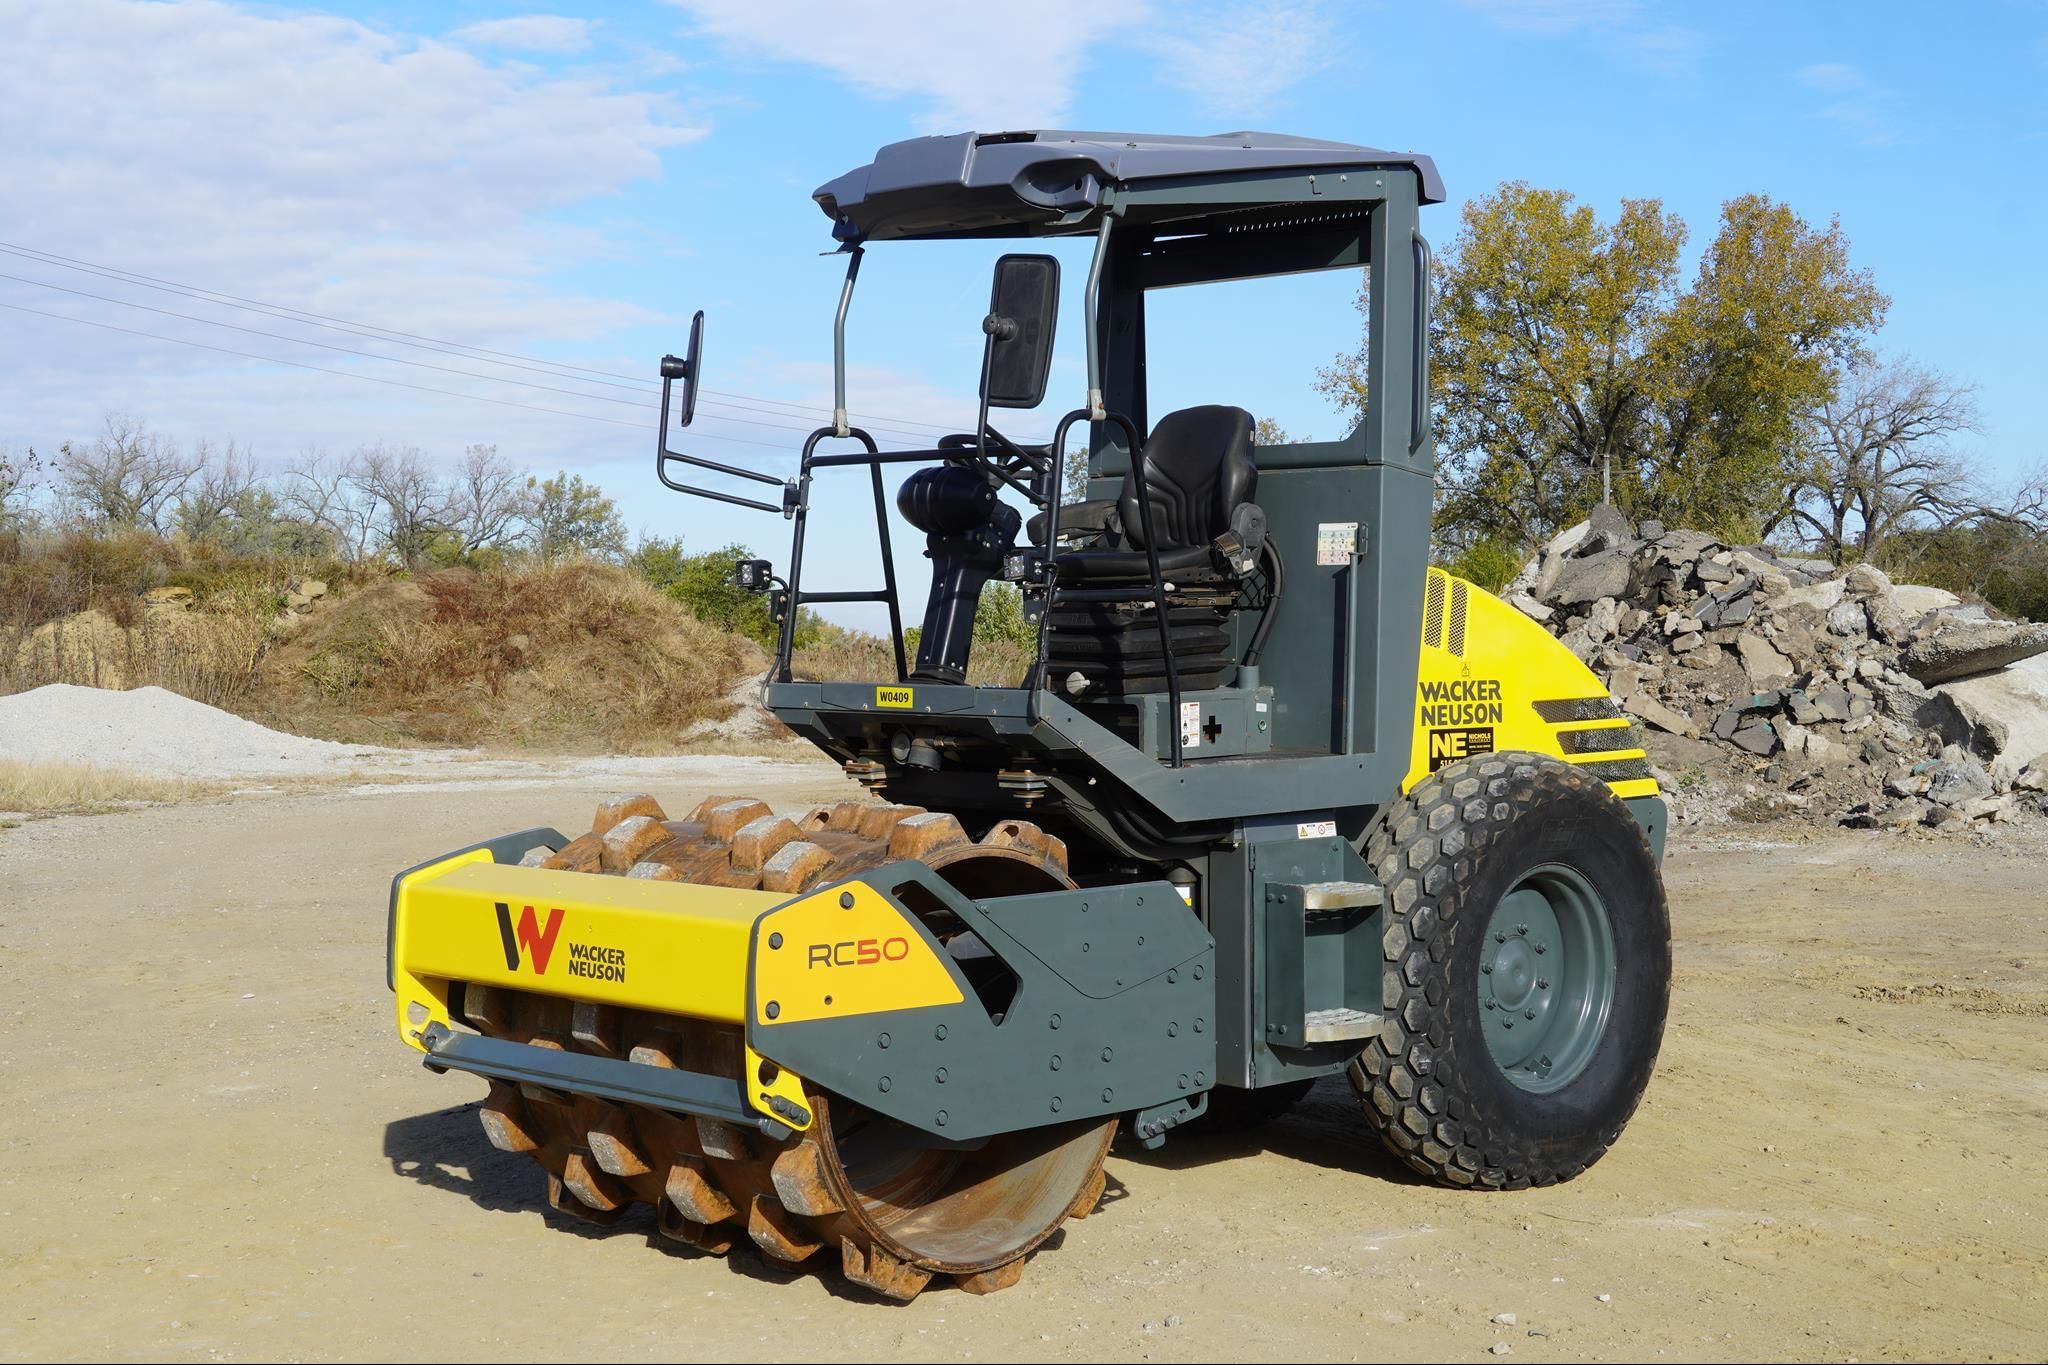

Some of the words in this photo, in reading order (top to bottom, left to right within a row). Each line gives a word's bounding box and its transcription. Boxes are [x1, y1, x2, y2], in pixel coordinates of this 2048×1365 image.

[880, 692, 909, 703] W0409
[1419, 680, 1502, 702] WACKER
[1421, 703, 1502, 726] NEUSON
[1432, 733, 1467, 758] NE
[569, 943, 625, 966] WACKER
[808, 937, 909, 969] RC50
[569, 960, 625, 983] NEUSON
